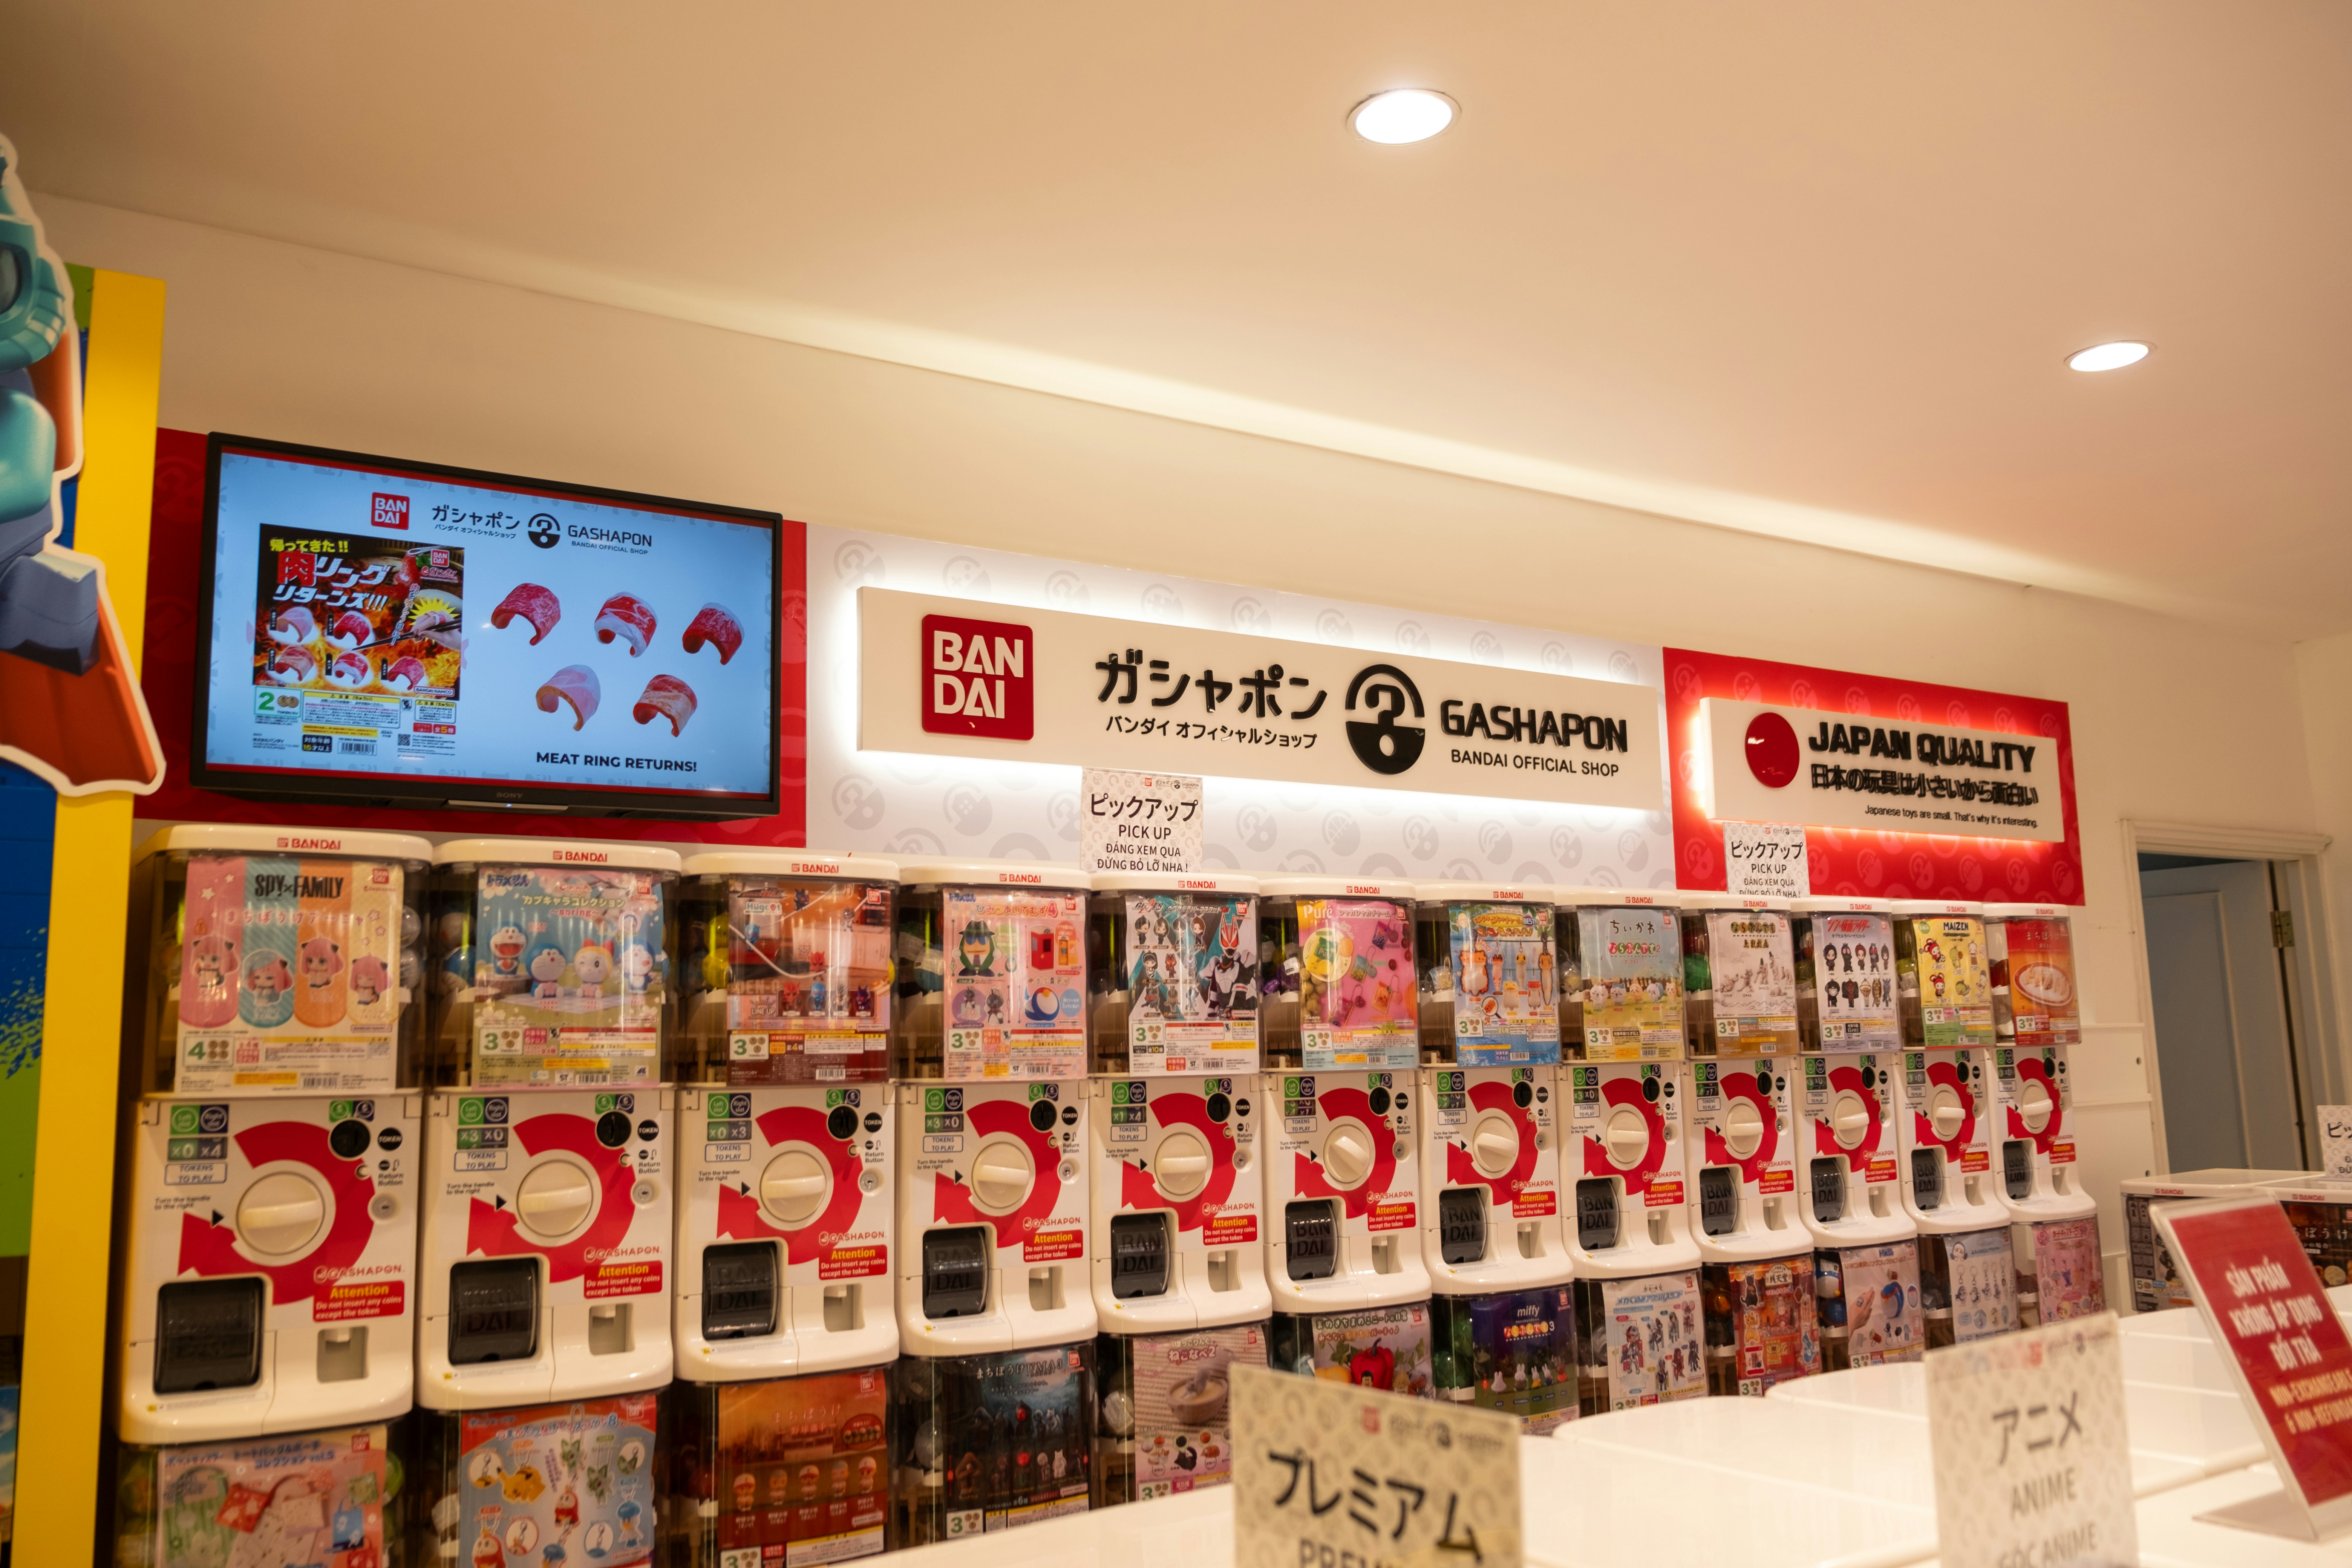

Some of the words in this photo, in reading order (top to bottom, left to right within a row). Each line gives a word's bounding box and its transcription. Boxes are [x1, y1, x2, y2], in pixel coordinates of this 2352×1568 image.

[376, 497, 407, 513] BAN
[375, 510, 400, 524] DAI
[432, 505, 520, 529] ガシャポン
[435, 524, 458, 533] バンダイ
[461, 527, 516, 539] オフィシャルショップ
[568, 525, 652, 547] GASHAPON
[571, 541, 597, 549] BANDAI
[599, 544, 628, 553] OFFICIAL
[277, 552, 394, 588] 肉リング
[934, 630, 1024, 678] BAN
[1095, 648, 1327, 720] ガシャポン
[259, 692, 274, 710] 2
[934, 674, 1005, 719] DAI
[1106, 716, 1170, 737] バンダイ
[1176, 721, 1318, 749] オフィシャルショップ
[1440, 700, 1628, 753] GASHAPON
[1808, 721, 1912, 761] JAPAN
[1917, 733, 2036, 772] QUALITY
[537, 752, 580, 764] MEAT
[584, 755, 621, 767] RING
[625, 757, 697, 772] RETURNS!
[1451, 749, 1507, 767] BANDAI
[1513, 755, 1577, 773] OFFICIAL
[1581, 761, 1619, 777] SHOP
[1811, 763, 2039, 806] 日本の玩具は小さいから面白い
[1091, 793, 1198, 822] ピックアップ
[1865, 804, 1901, 816] Japanese
[1902, 809, 1918, 819] toys
[1920, 810, 1931, 819] are
[1933, 811, 1952, 820] small.
[1954, 812, 1975, 821] That's
[1977, 815, 1990, 824] why
[1991, 815, 2001, 824] it's
[2003, 816, 2038, 828] interesting.
[1119, 824, 1150, 839] PICK
[1153, 827, 1171, 840] UP
[291, 838, 341, 850] BANDAI
[1106, 841, 1134, 854] ĐÁNG
[1137, 845, 1157, 856] XEM
[1160, 847, 1181, 858] QUA
[1731, 840, 1804, 860] ピックアップ
[565, 851, 608, 862] BANDAI
[802, 864, 839, 874] BANDAI
[1097, 856, 1127, 870] ĐỪNG
[1130, 858, 1144, 871] BỎ
[1147, 859, 1160, 871] LỠ
[1162, 862, 1183, 873] NHA
[1751, 863, 1772, 874] PICK
[1775, 864, 1787, 874] UP
[1009, 874, 1041, 884] BANDAI
[1187, 881, 1216, 889] BANDAI
[1744, 876, 1763, 885] ĐÁNG
[1780, 879, 1795, 888] QUA
[1354, 886, 1380, 894] BANDAI
[522, 896, 625, 908] カプキャラコレクション
[1303, 905, 1333, 919] Puré
[1338, 909, 1391, 918] シャカシャカチャーム
[1609, 919, 1655, 935] ちいかわ
[1730, 922, 1776, 934] ならぶんです
[1943, 922, 1969, 931] MAIZEN
[1743, 939, 1769, 948] 鳥獣戯画
[1926, 1011, 1934, 1021] 3
[951, 1033, 963, 1048] 3
[1589, 1031, 1599, 1043] 3
[188, 1041, 206, 1060] 4
[734, 1038, 747, 1055] 3
[1870, 1161, 1891, 1170] Attention
[1651, 1183, 1677, 1192] Attention
[1374, 1191, 1413, 1201] GASHAPON
[1376, 1205, 1407, 1215] Attention
[1032, 1217, 1081, 1227] GASHAPON
[1213, 1217, 1248, 1228] Attention
[829, 1231, 885, 1243] GASHAPON
[1034, 1232, 1073, 1244] Attention
[831, 1248, 876, 1260] Attention
[326, 1264, 402, 1280] GASHAPON
[598, 1264, 649, 1278] Attention
[330, 1285, 389, 1299] Attention
[1517, 1305, 1540, 1317] miffy
[1168, 1345, 1216, 1361] ねこなべ2
[773, 1404, 841, 1424] まちぼうけ
[1992, 1391, 2082, 1467] アニメ
[2010, 1467, 2077, 1520] ANIME
[1269, 1448, 1483, 1563] プレミアム
[951, 1517, 963, 1533] 3
